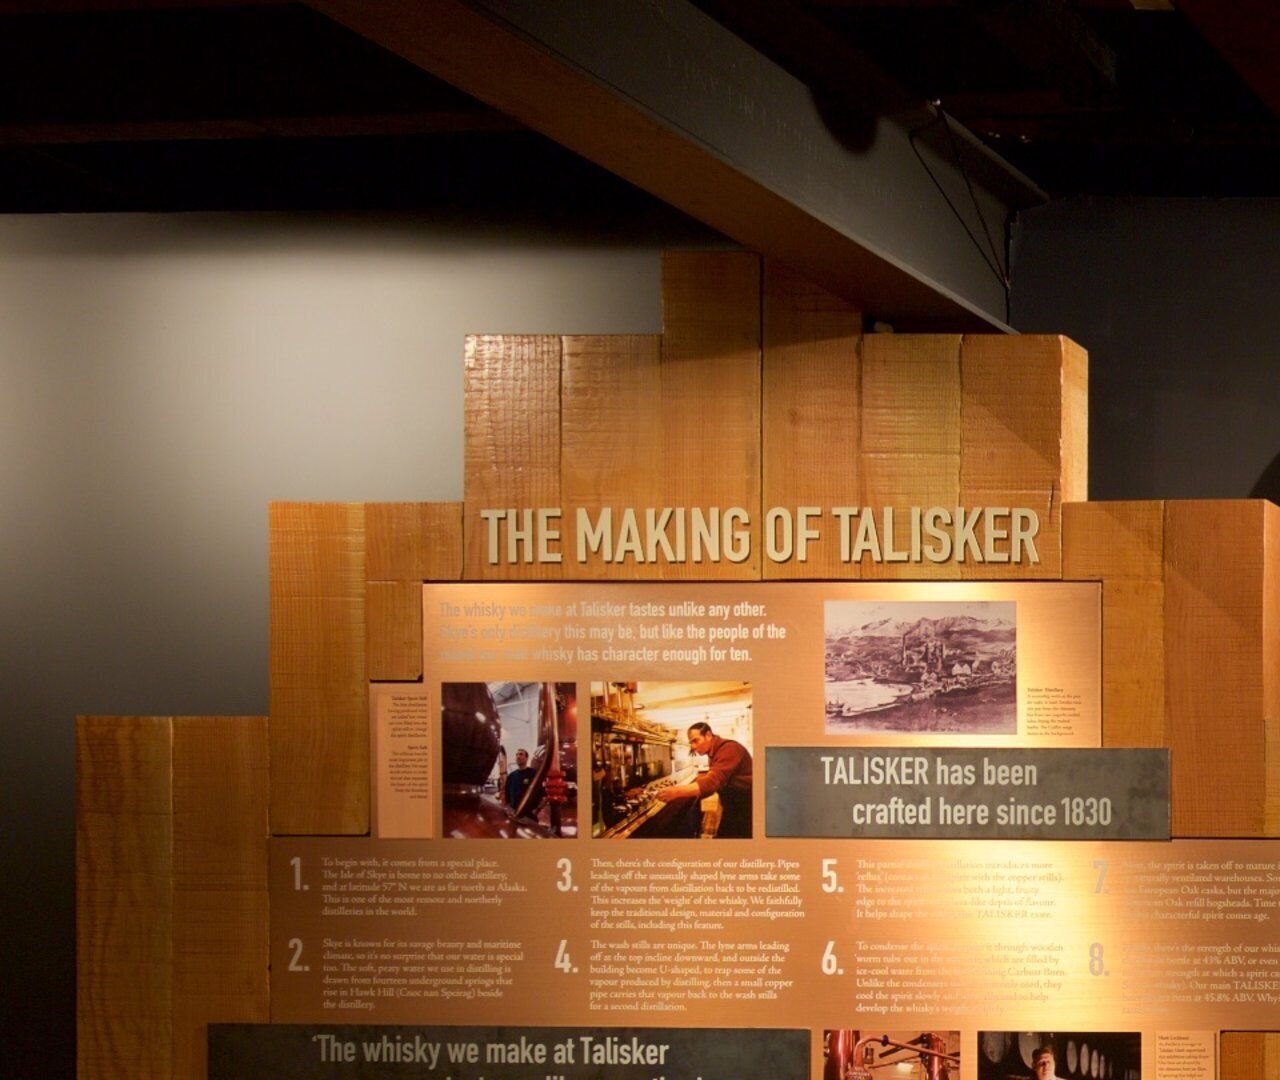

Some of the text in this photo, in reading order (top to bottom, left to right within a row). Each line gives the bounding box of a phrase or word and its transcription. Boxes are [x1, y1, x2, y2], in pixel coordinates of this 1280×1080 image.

[480, 506, 1040, 564] THE MAKING OF TALISKER
[566, 601, 767, 620] at Talisker tastes unlike any other.
[564, 624, 585, 640] this
[589, 627, 614, 643] may
[640, 624, 659, 639] but
[662, 624, 683, 639] like
[687, 624, 705, 639] the
[709, 624, 749, 642] people
[752, 624, 765, 639] of
[767, 624, 786, 639] the
[577, 646, 598, 661] has
[602, 647, 659, 662] character
[663, 646, 706, 665] enough
[710, 646, 727, 661] for
[730, 647, 752, 662] ten.
[821, 756, 1037, 786] TALISKER has been
[852, 797, 1112, 826] crafted here since 1830
[556, 858, 579, 892] 3.
[821, 858, 844, 893] 5.
[554, 939, 579, 973] 4.
[821, 940, 844, 975] 6.
[362, 1035, 441, 1070] whisky
[447, 1042, 479, 1063] we
[486, 1036, 547, 1064] make
[553, 1037, 575, 1064] at
[580, 1036, 670, 1065] Talisker
